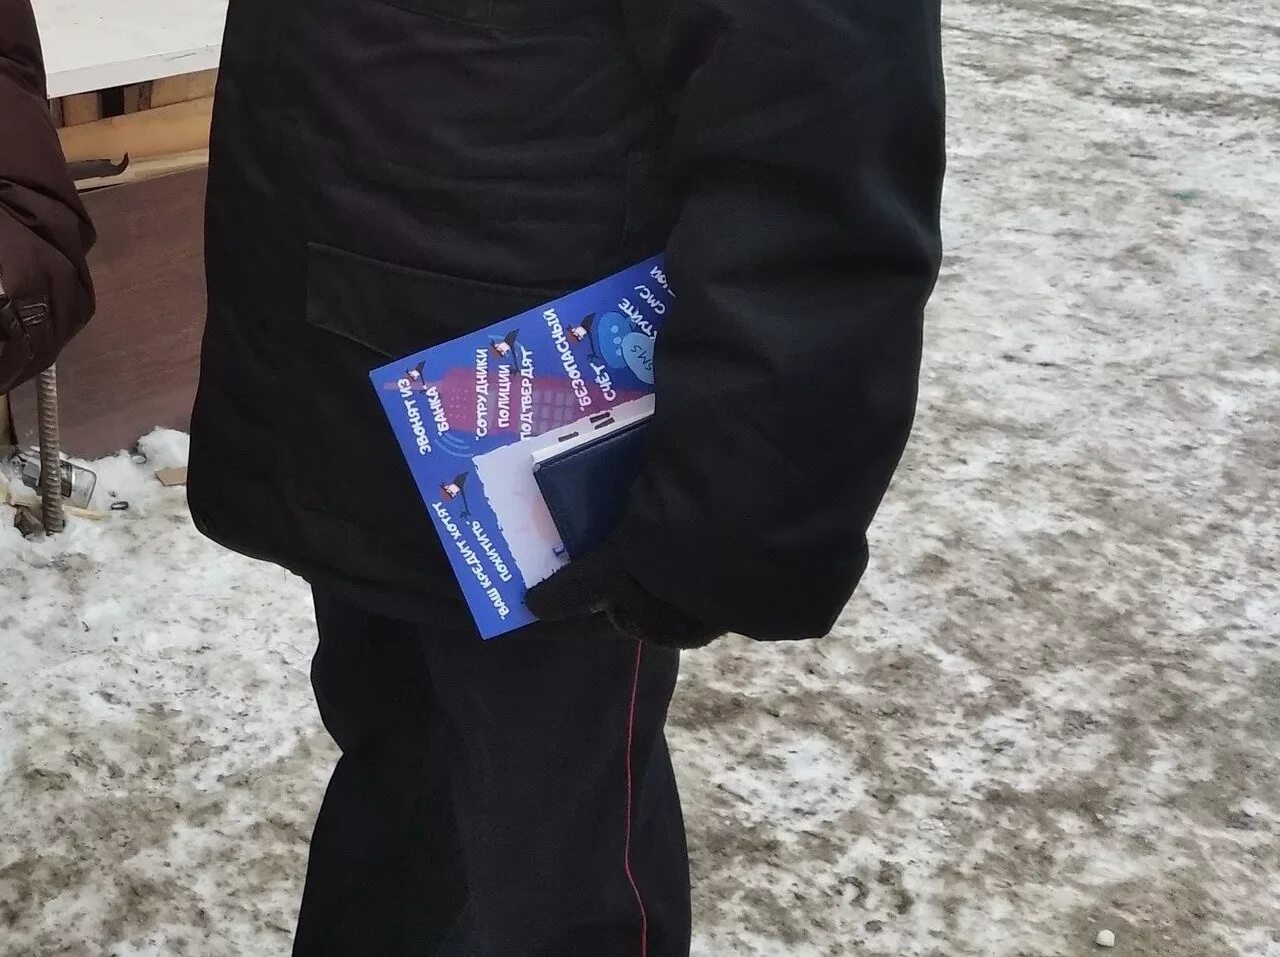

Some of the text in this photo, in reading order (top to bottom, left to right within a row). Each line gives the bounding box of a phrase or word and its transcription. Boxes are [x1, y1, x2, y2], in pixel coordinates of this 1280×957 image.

[630, 344, 654, 371] SMS
[397, 378, 432, 455] ЗВОНЯТ ИЗ
[497, 364, 512, 428] ПОЛИЦИИ
[432, 501, 462, 540] ХОТЯТ
[456, 540, 492, 589] КРЕДИТ
